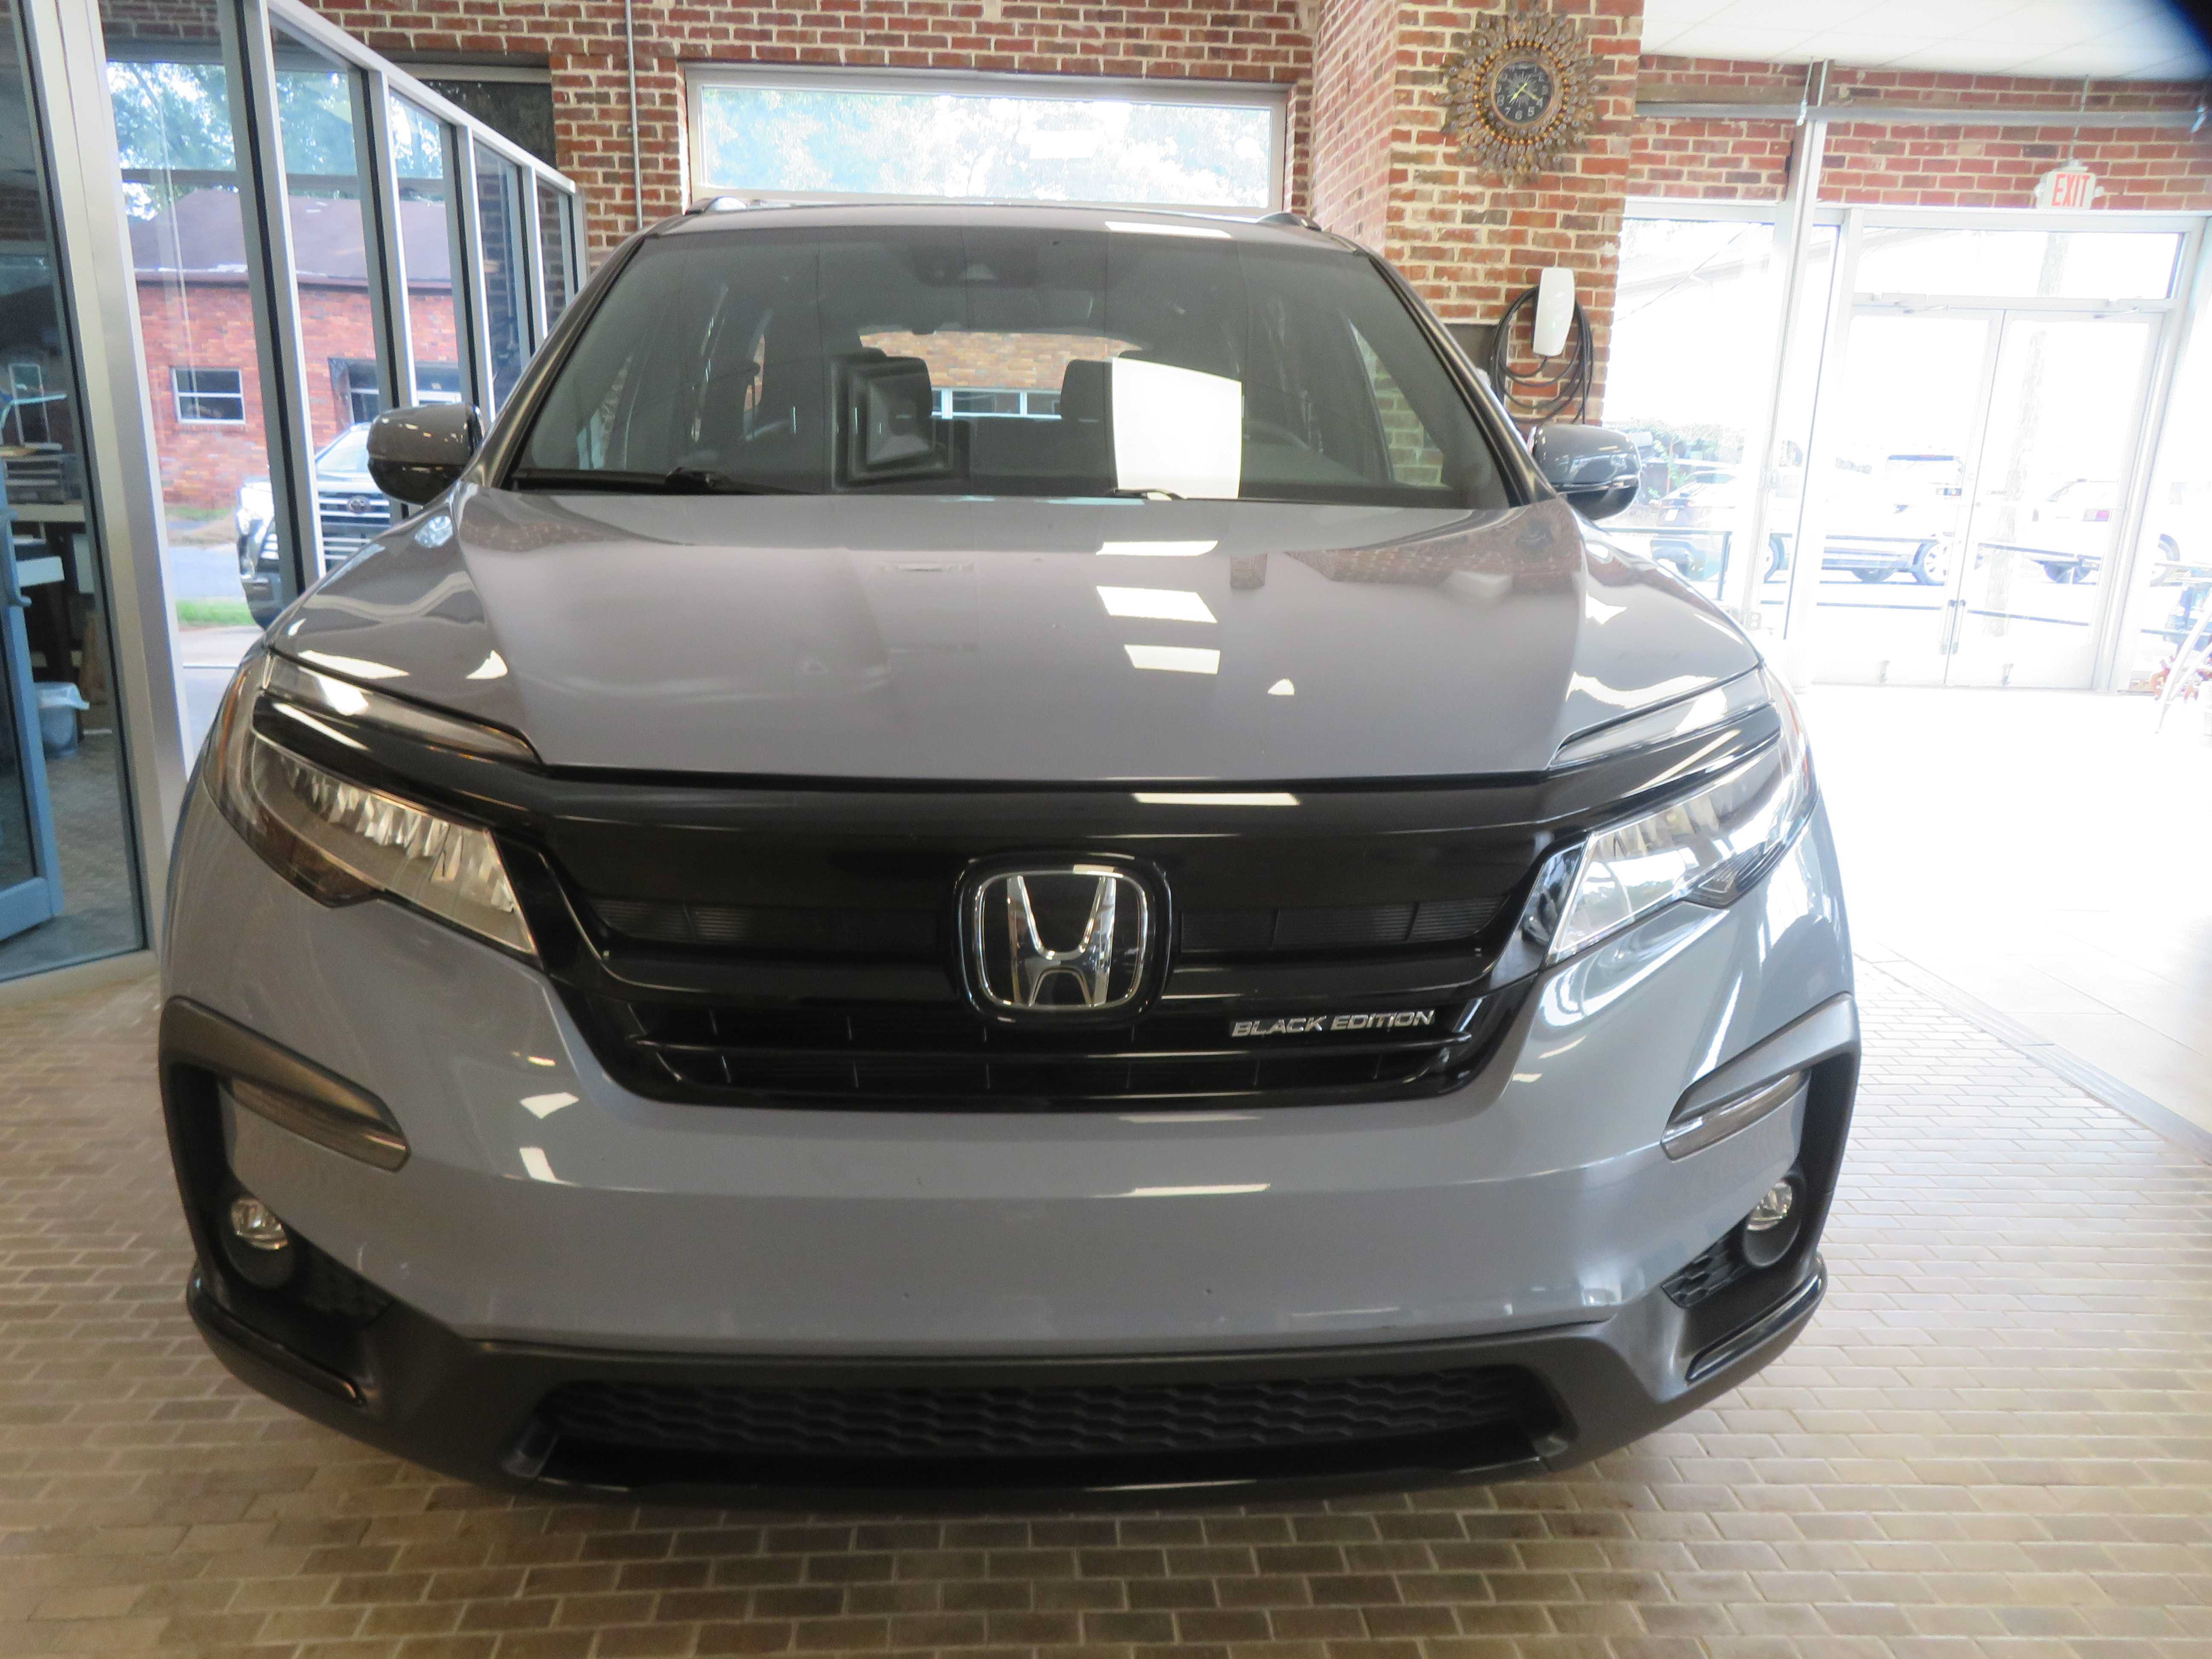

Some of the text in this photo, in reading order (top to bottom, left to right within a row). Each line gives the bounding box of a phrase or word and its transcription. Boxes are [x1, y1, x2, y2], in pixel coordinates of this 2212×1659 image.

[1536, 97, 1543, 108] 4
[1505, 106, 1512, 116] 7
[1528, 106, 1535, 117] 5
[2051, 173, 2090, 207] EXIT
[1231, 1009, 1435, 1038] BLACK EDITION
